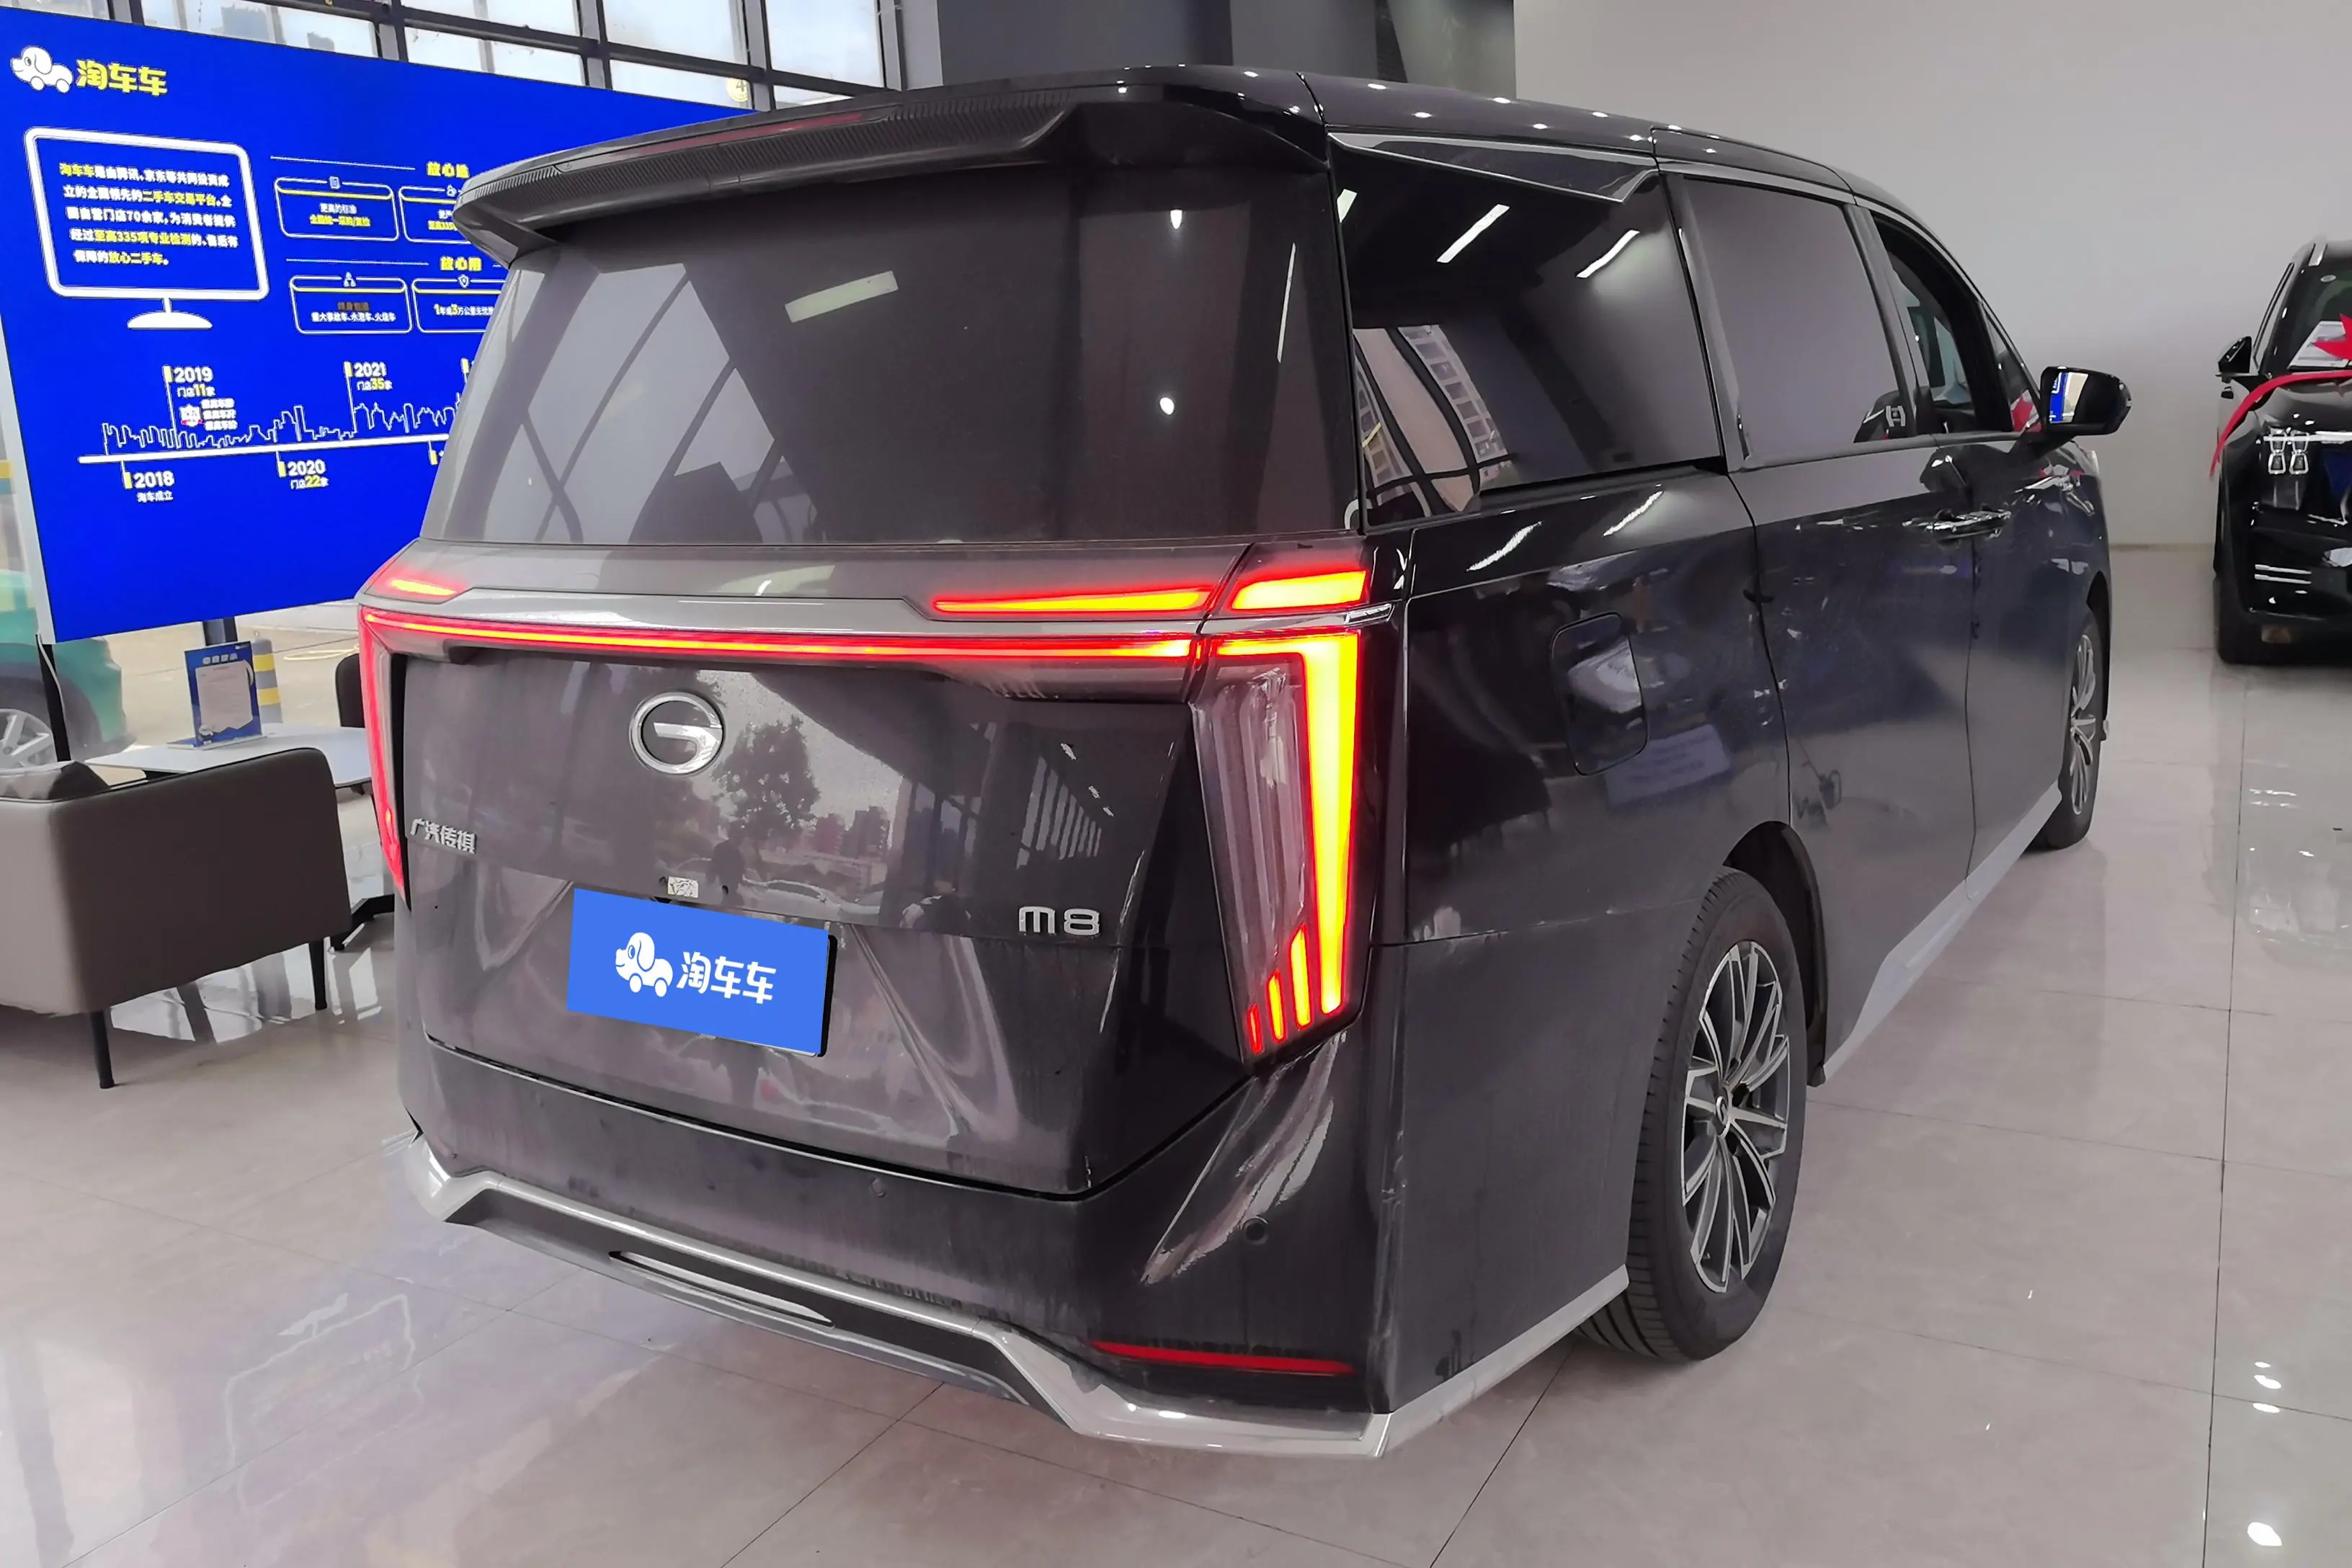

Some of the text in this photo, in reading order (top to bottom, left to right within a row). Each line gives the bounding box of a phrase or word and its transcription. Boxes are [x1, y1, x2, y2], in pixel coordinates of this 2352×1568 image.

[76, 59, 168, 97] 淘车车
[174, 367, 213, 383] 2019
[354, 362, 387, 377] 2021
[288, 459, 326, 476] 2020
[134, 471, 174, 489] 2018
[410, 819, 477, 854] 广汽传祺
[1019, 906, 1100, 935] M8
